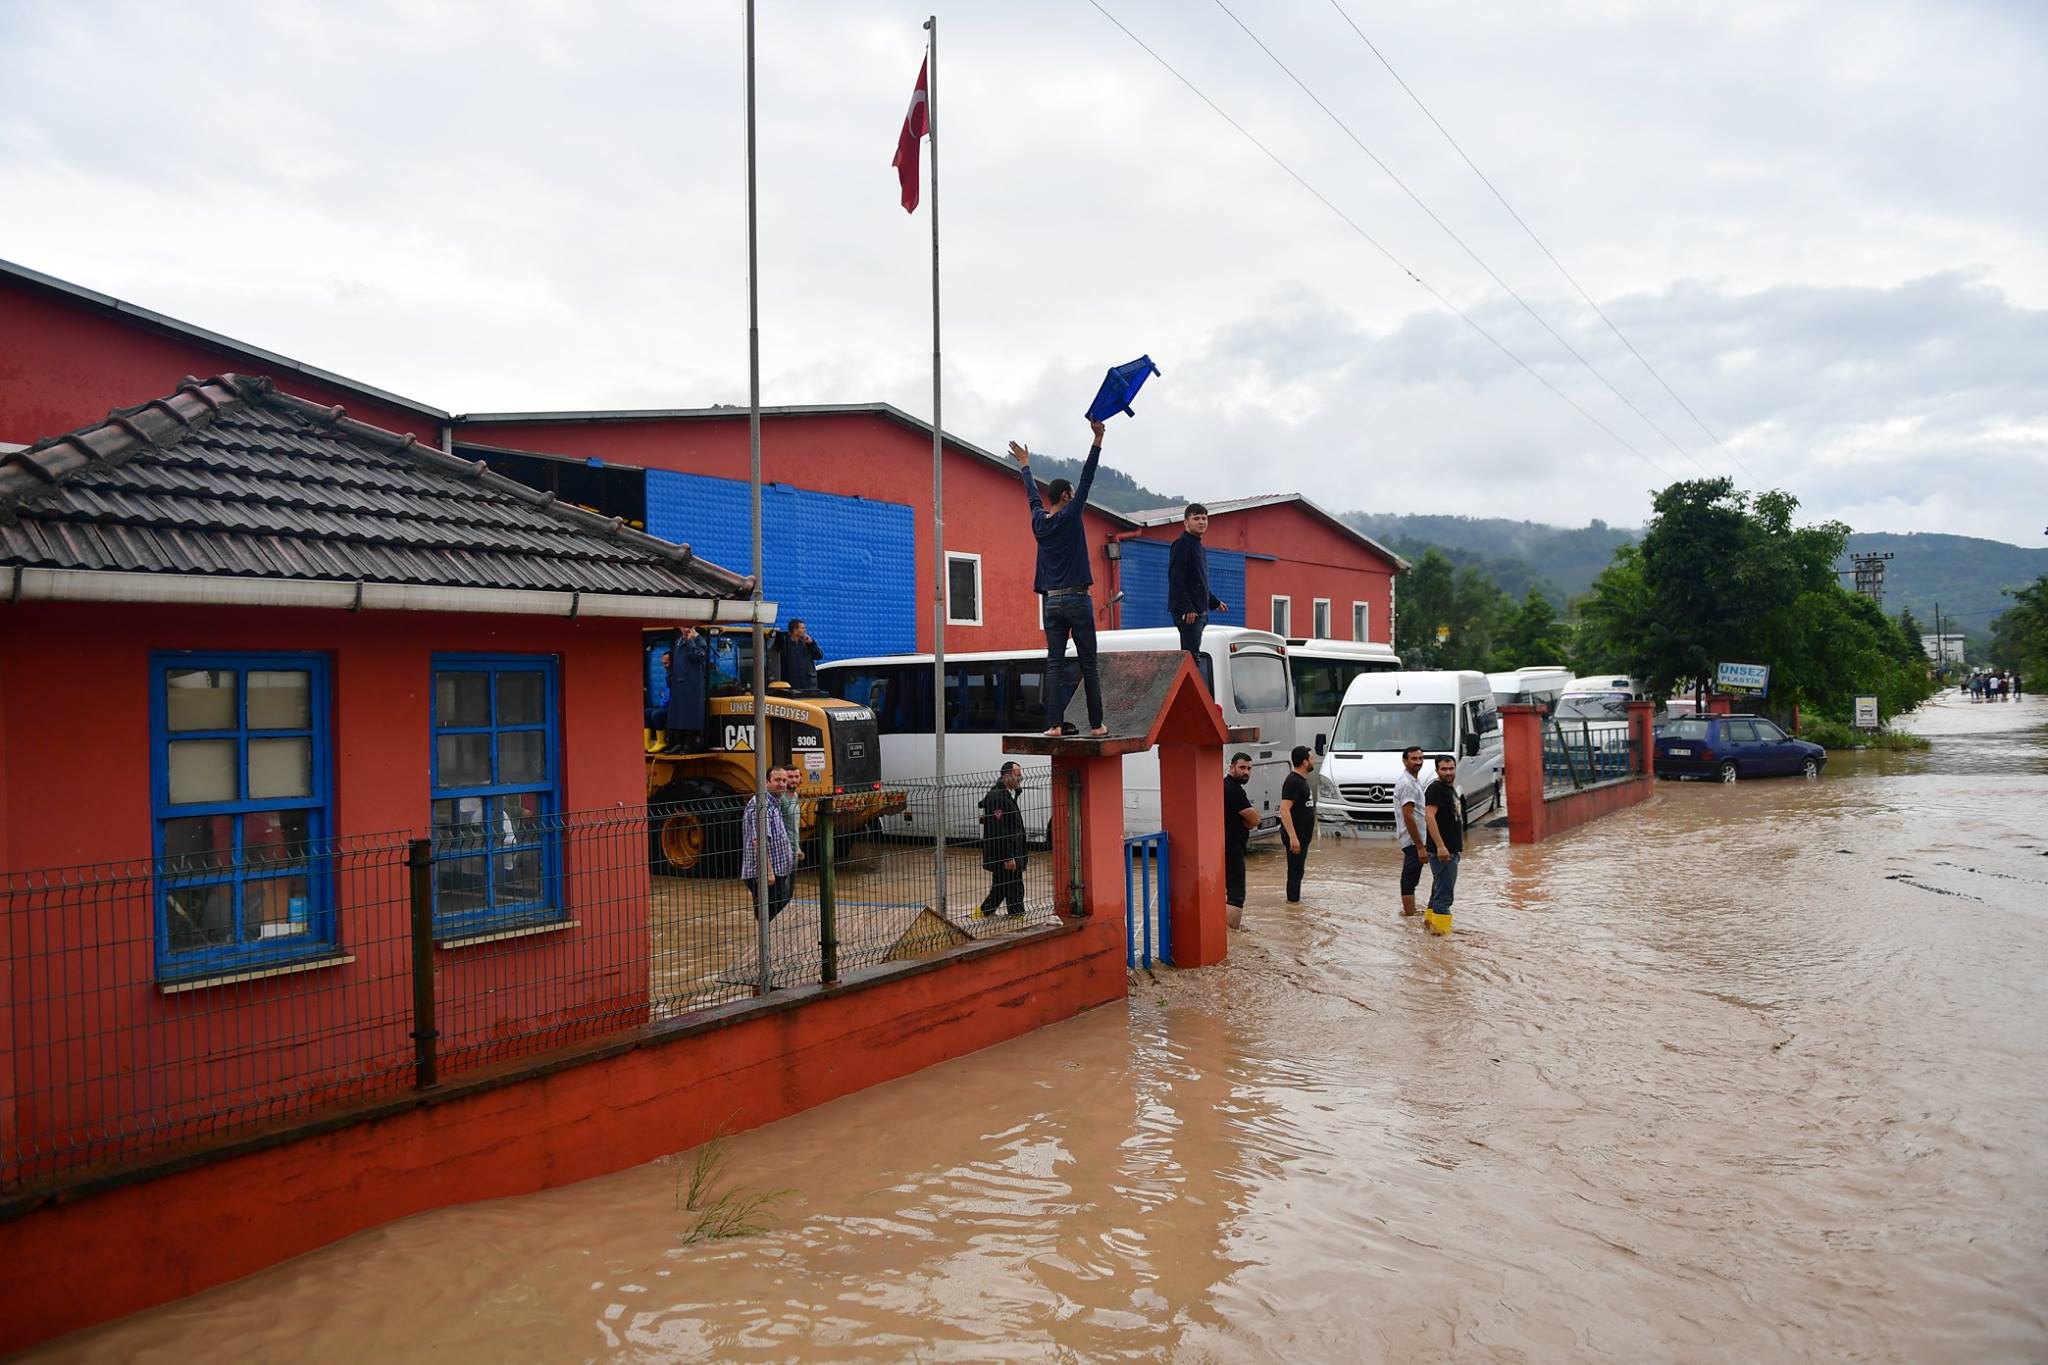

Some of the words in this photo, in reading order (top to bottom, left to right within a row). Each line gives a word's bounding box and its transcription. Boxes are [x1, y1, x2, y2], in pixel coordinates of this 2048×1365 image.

[764, 703, 809, 721] ELEDIYESI
[725, 724, 755, 751] CAT
[797, 735, 817, 746] 930G
